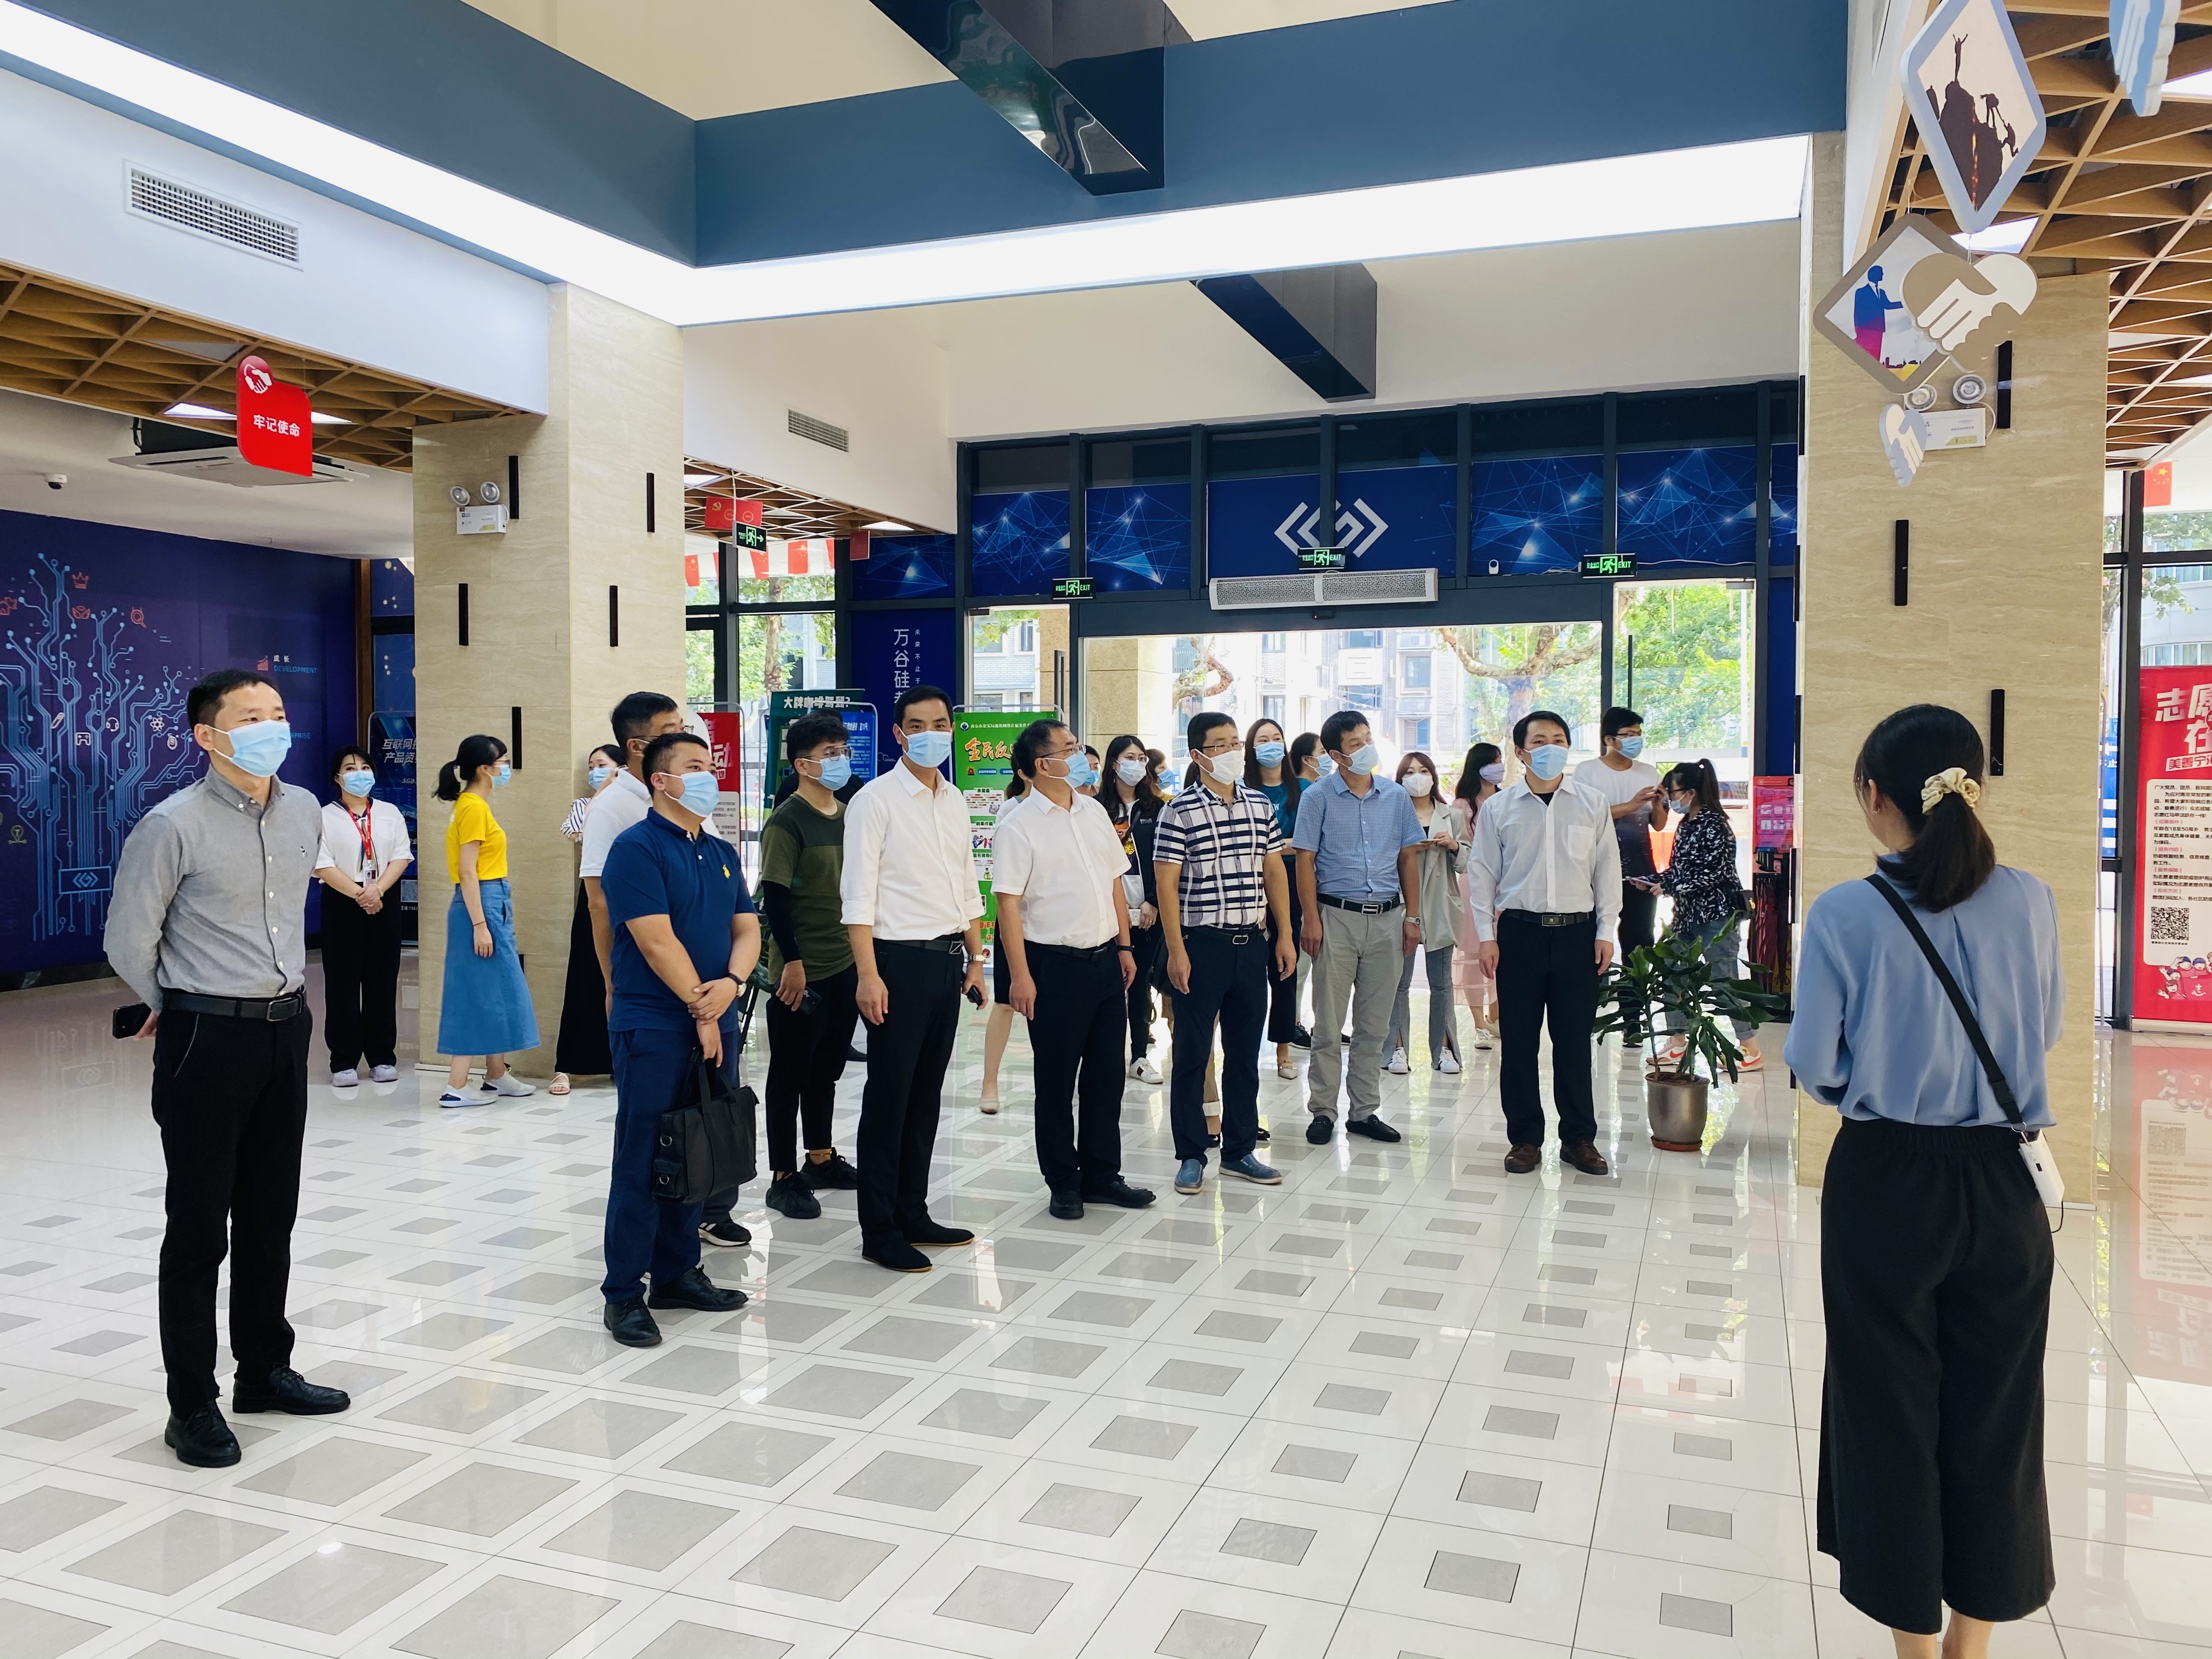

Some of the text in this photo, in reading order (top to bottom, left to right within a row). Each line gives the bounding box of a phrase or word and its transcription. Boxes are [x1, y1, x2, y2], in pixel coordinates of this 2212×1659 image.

[253, 414, 300, 437] 牢记使命
[274, 665, 318, 674] DEVELOPMENT
[384, 752, 417, 764] 产品资
